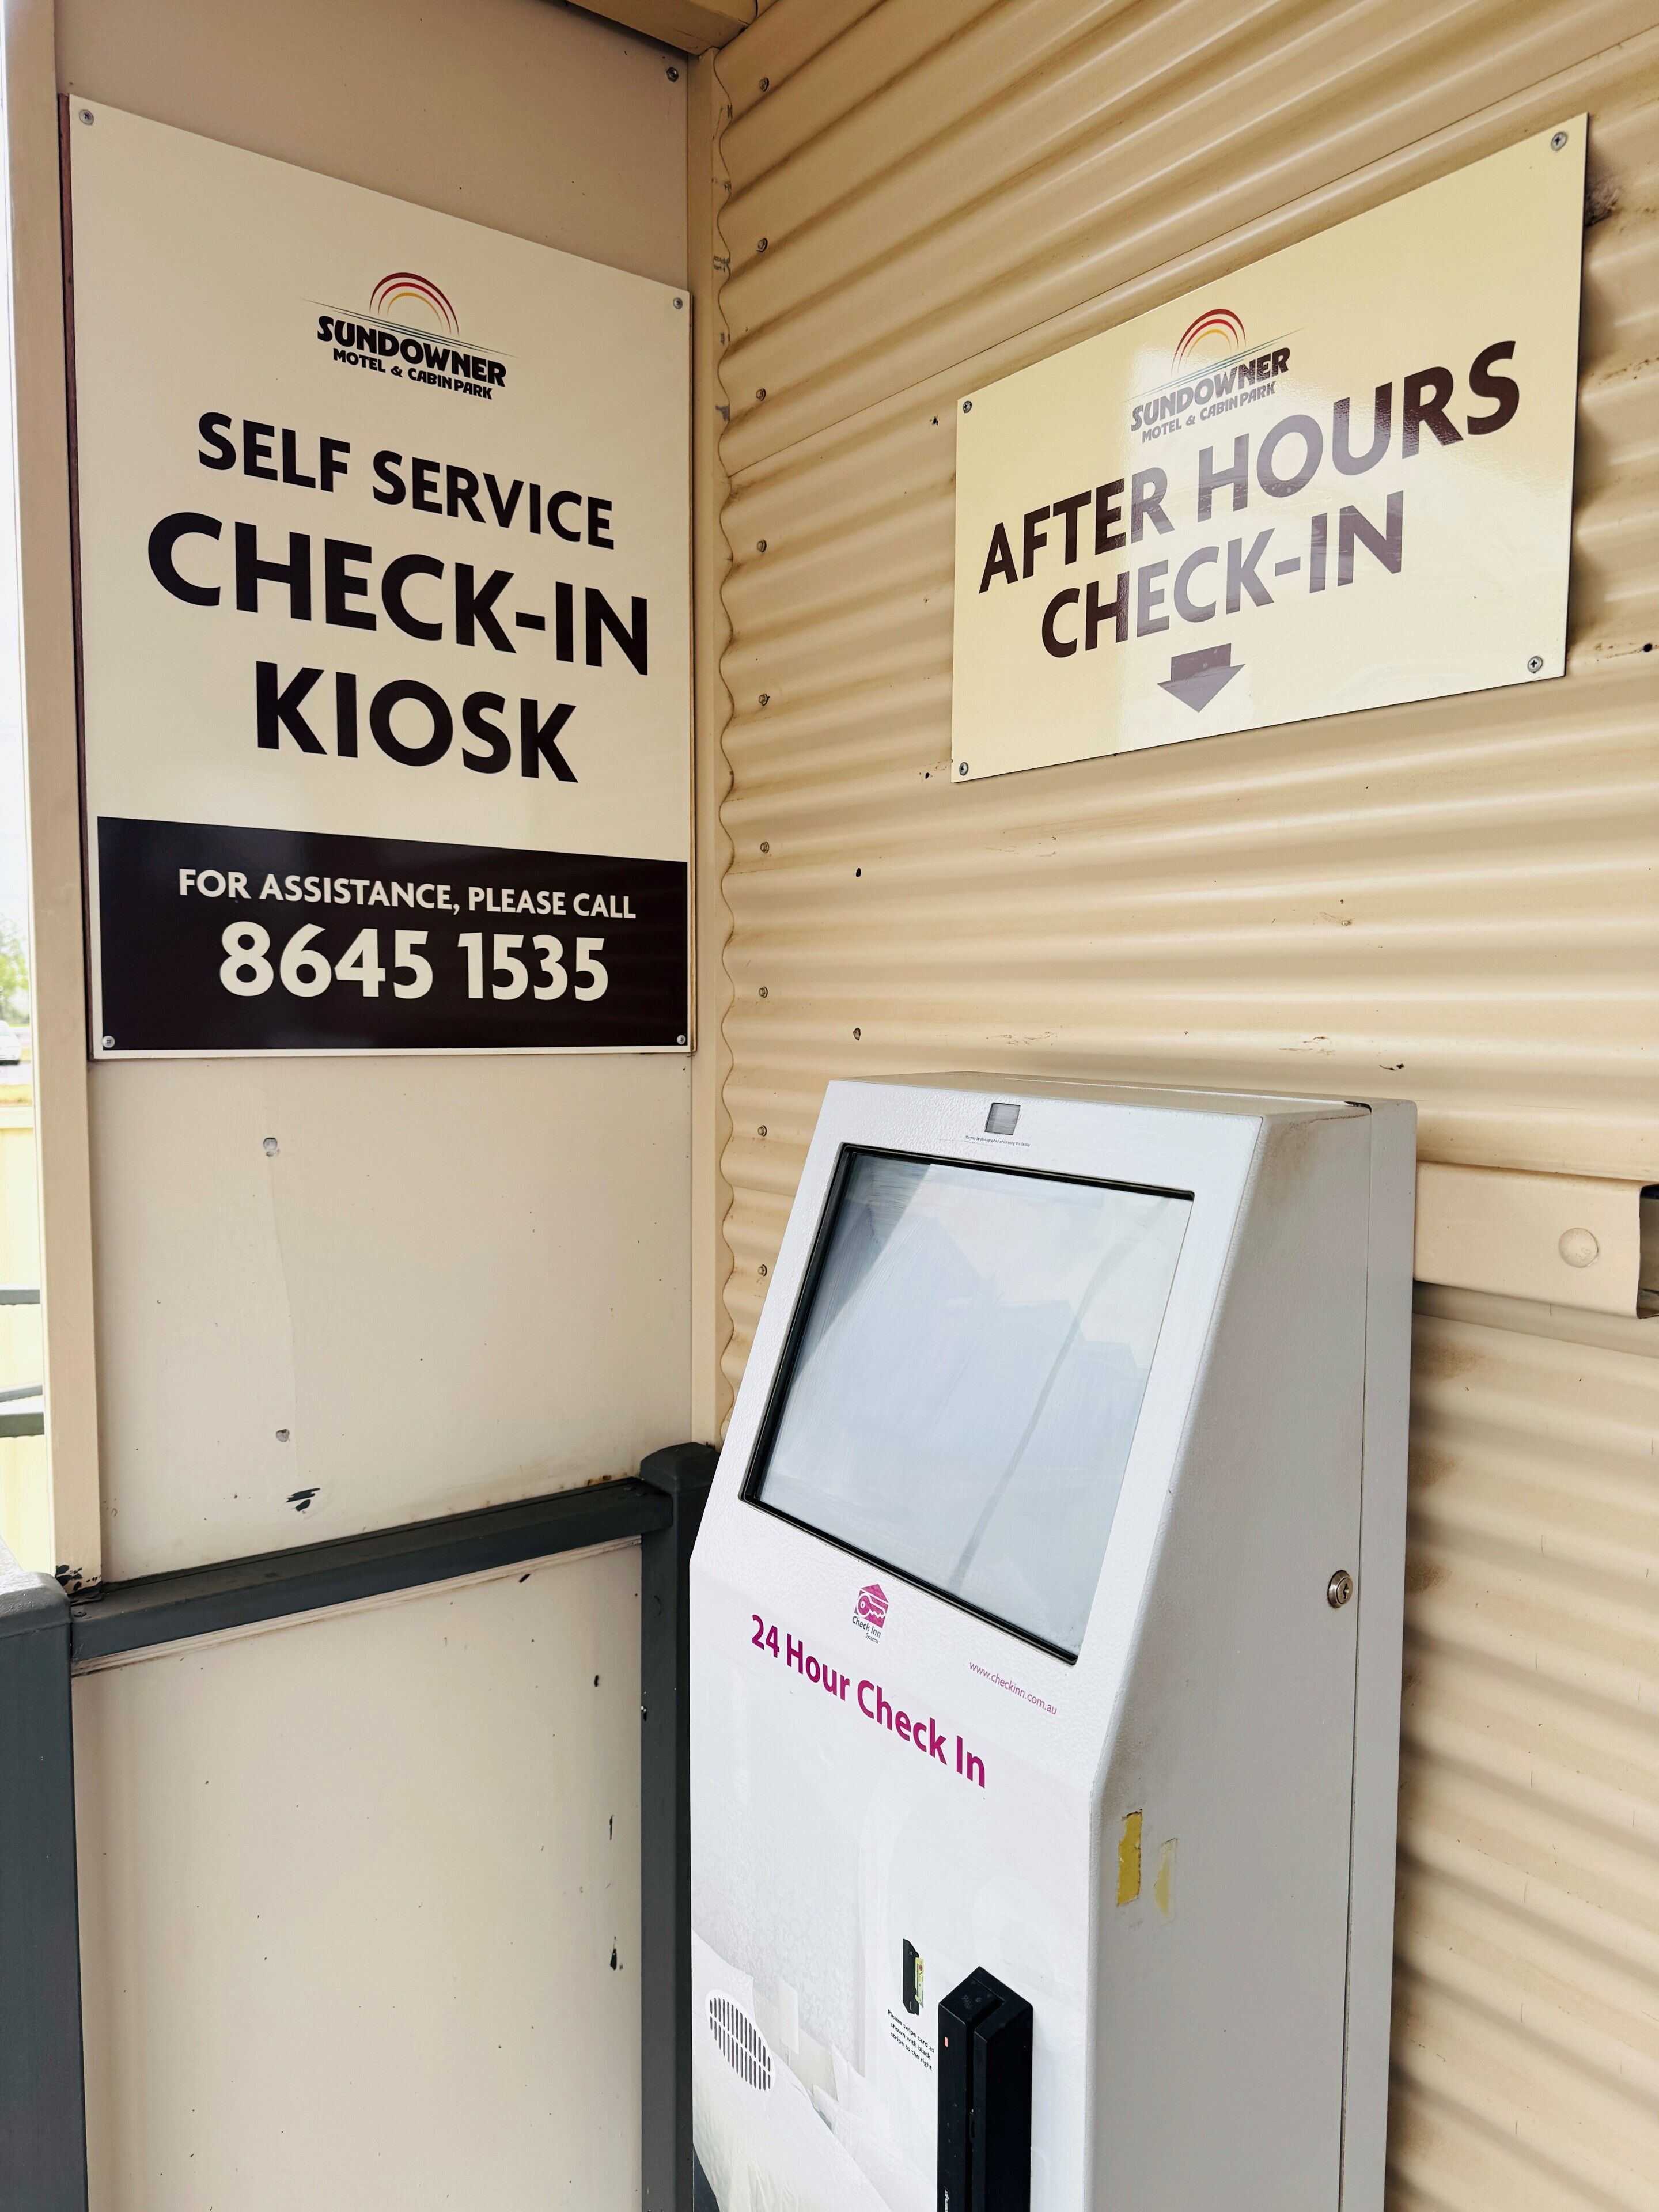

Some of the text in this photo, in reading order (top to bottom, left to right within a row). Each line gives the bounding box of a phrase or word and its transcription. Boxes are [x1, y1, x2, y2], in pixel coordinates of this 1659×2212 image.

[317, 316, 506, 387] SUNDOWNER
[333, 348, 493, 400] MOTEL & CABIN PARK
[1131, 347, 1290, 431] SUNDOWNER
[1142, 381, 1276, 443] MOTEL & CABIN PARK
[197, 411, 615, 550] SELF SERVICE
[978, 340, 1520, 594] AFTER HOURS
[147, 511, 648, 676] CHECK-IN
[1041, 490, 1404, 658] CHECK-IN
[256, 661, 579, 783] KIOSK
[179, 869, 636, 919] FOR ASSISTANCE, PLEASE CALL
[219, 921, 609, 1002] 8645 1535
[852, 1615, 881, 1638] Check Inn
[751, 1614, 986, 1789] 24 Hour Check In
[969, 1662, 1057, 1715] www.checkinn.com.au
[888, 2009, 902, 2025] Please
[903, 2024, 916, 2037] swipe
[917, 2036, 928, 2047] card
[891, 2023, 930, 2060] shown with black
[891, 2032, 904, 2046] stripe
[921, 2058, 932, 2071] right
